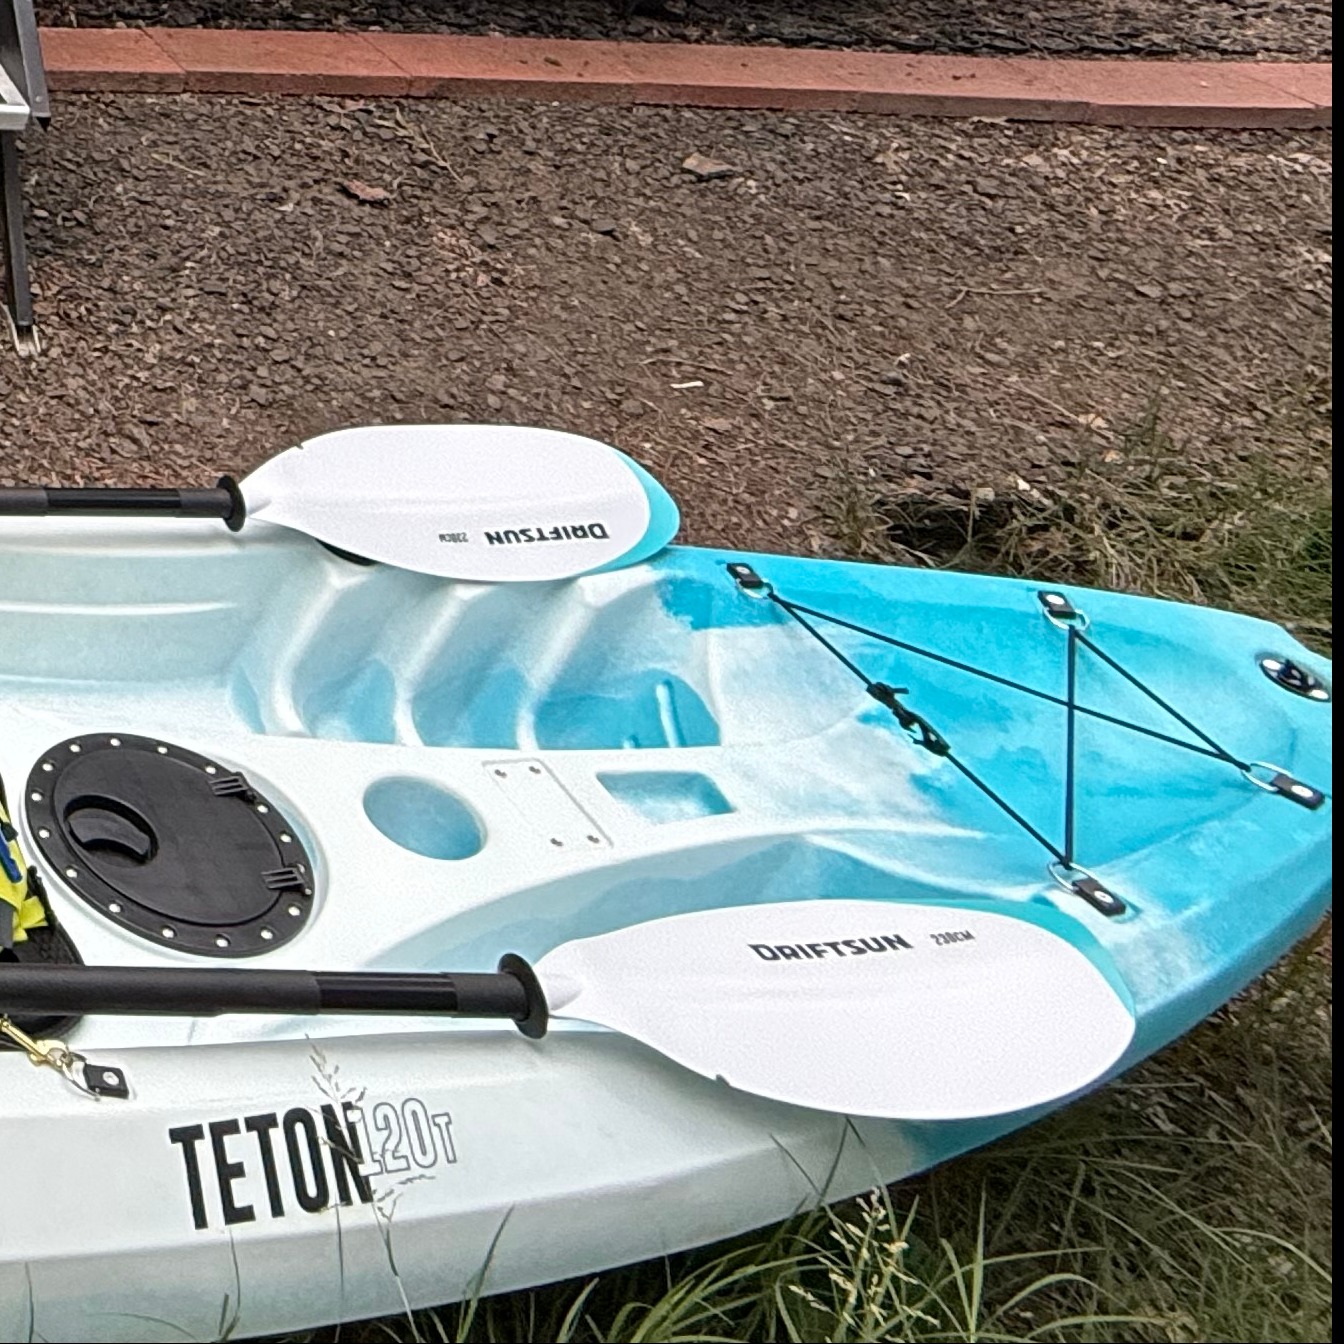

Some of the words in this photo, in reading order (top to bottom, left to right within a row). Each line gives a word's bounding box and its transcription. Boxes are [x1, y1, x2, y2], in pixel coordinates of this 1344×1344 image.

[483, 522, 611, 545] DRIFTSUN
[748, 934, 914, 962] DRIFTSUN
[930, 930, 976, 946] 230CM
[169, 1101, 374, 1230] TETON
[346, 1097, 458, 1177] 120T
